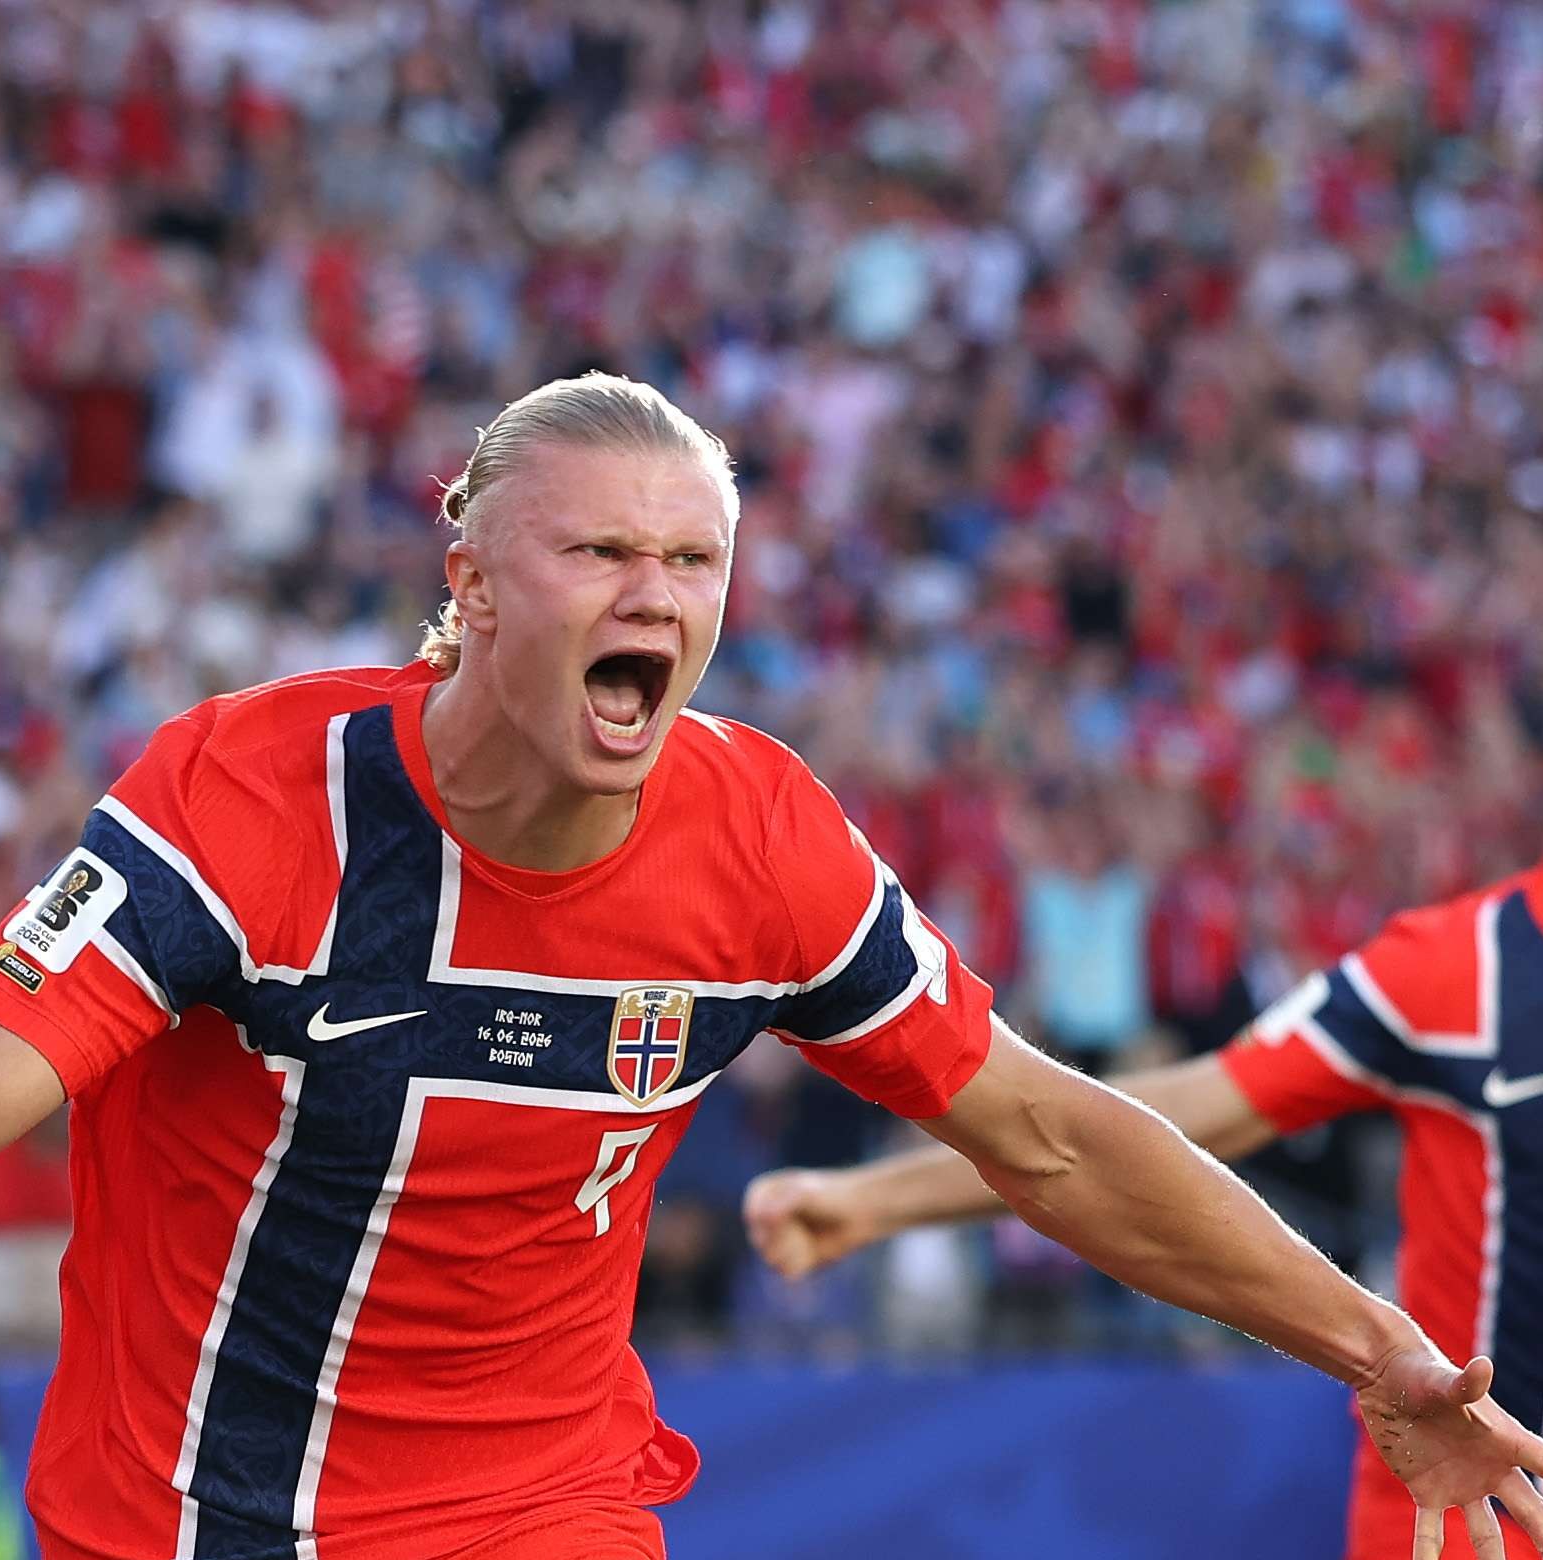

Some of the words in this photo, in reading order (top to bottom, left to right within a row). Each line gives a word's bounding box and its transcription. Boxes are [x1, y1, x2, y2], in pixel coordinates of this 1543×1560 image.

[40, 907, 58, 924] FIFA
[17, 926, 51, 953] 2026
[41, 929, 57, 943] CUP
[4, 956, 40, 982] DEBUT
[494, 1008, 543, 1026] IRQ-NOR
[488, 1047, 534, 1067] BOSTON
[574, 1122, 659, 1238] 9
